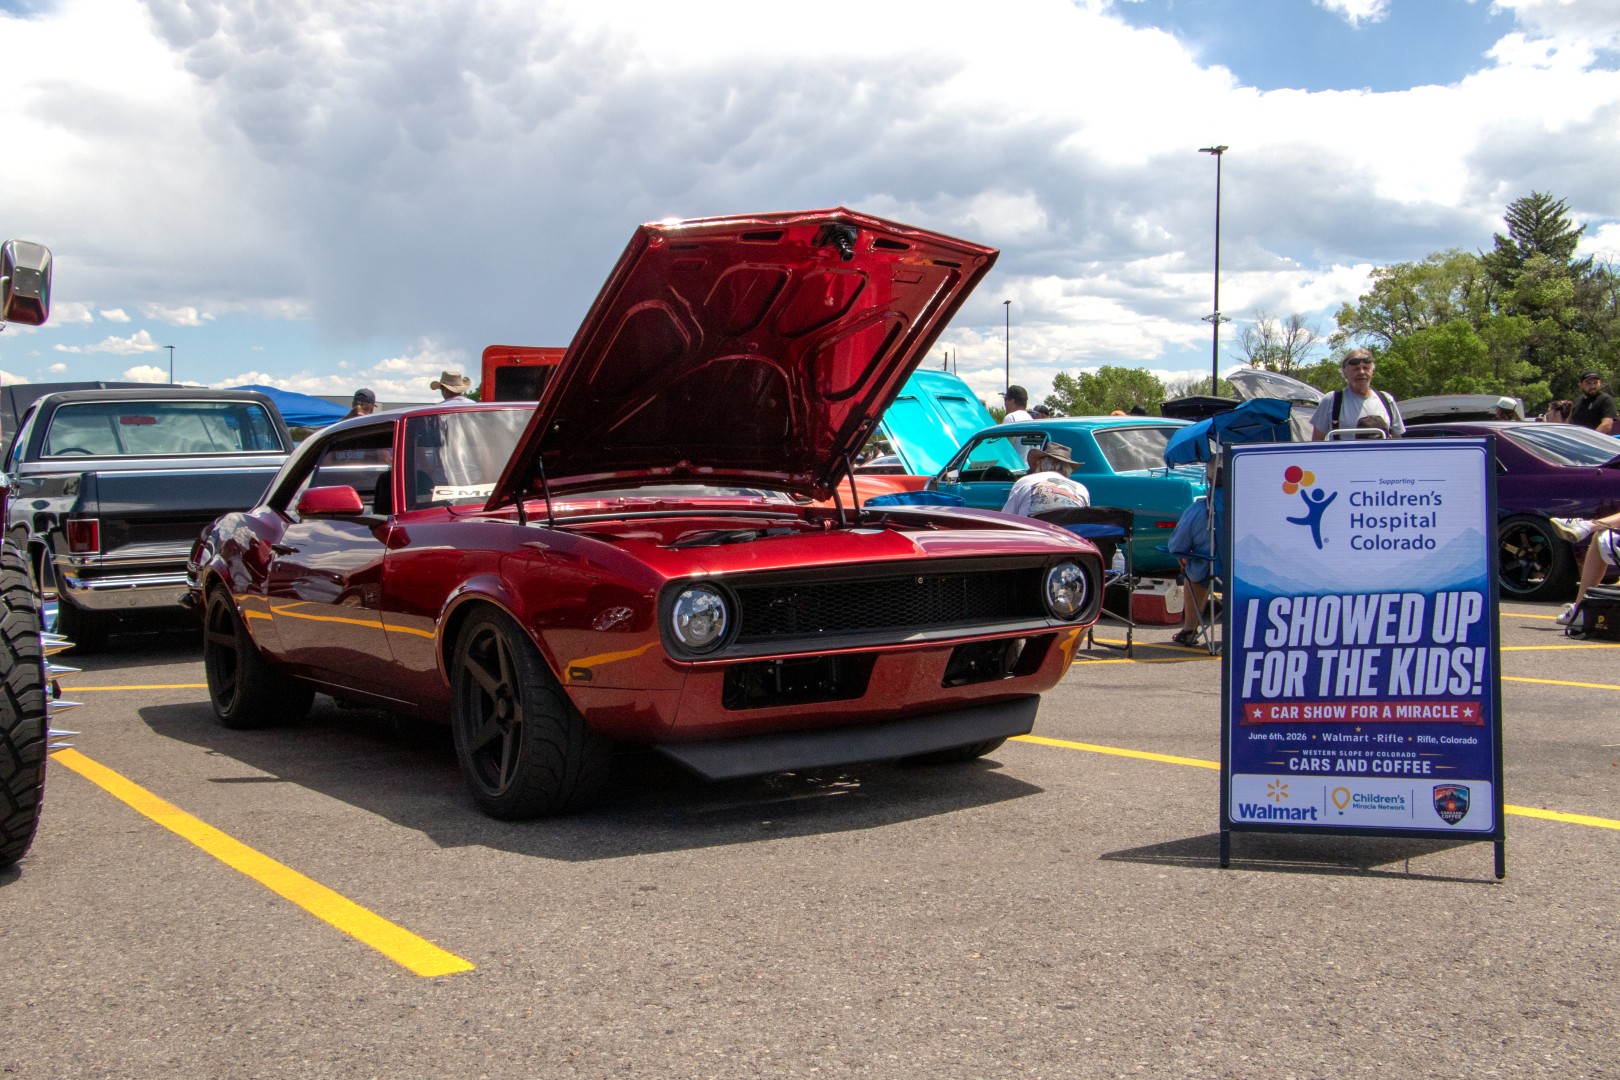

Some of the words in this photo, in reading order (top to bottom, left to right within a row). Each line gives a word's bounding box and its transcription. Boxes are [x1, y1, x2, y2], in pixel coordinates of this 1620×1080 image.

[1378, 478, 1415, 486] Supporting
[1349, 490, 1442, 507] Children's
[1350, 511, 1436, 532] Hospital
[1350, 533, 1436, 550] Colorado
[1243, 598, 1260, 649] I
[1264, 592, 1425, 648] SHOWED
[1432, 591, 1483, 643] UP
[1241, 650, 1309, 699] FOR
[1317, 648, 1381, 697] THE
[1388, 646, 1486, 696] KIDS!
[1270, 706, 1299, 719] CAR
[1303, 705, 1347, 718] SHOW
[1351, 705, 1378, 718] FOR
[1382, 705, 1392, 718] A
[1396, 705, 1459, 718] MIRACLE
[1248, 732, 1267, 740] June
[1269, 733, 1285, 741] 6th,
[1286, 733, 1307, 741] 2026
[1322, 733, 1369, 742] Walmart
[1417, 735, 1439, 744] Rifle,
[1440, 736, 1478, 745] Colorado
[1289, 758, 1331, 771] CARS
[1335, 759, 1368, 772] AND
[1372, 760, 1431, 774] COFFEE
[1352, 793, 1405, 804] Children's
[1239, 803, 1317, 821] Walmart
